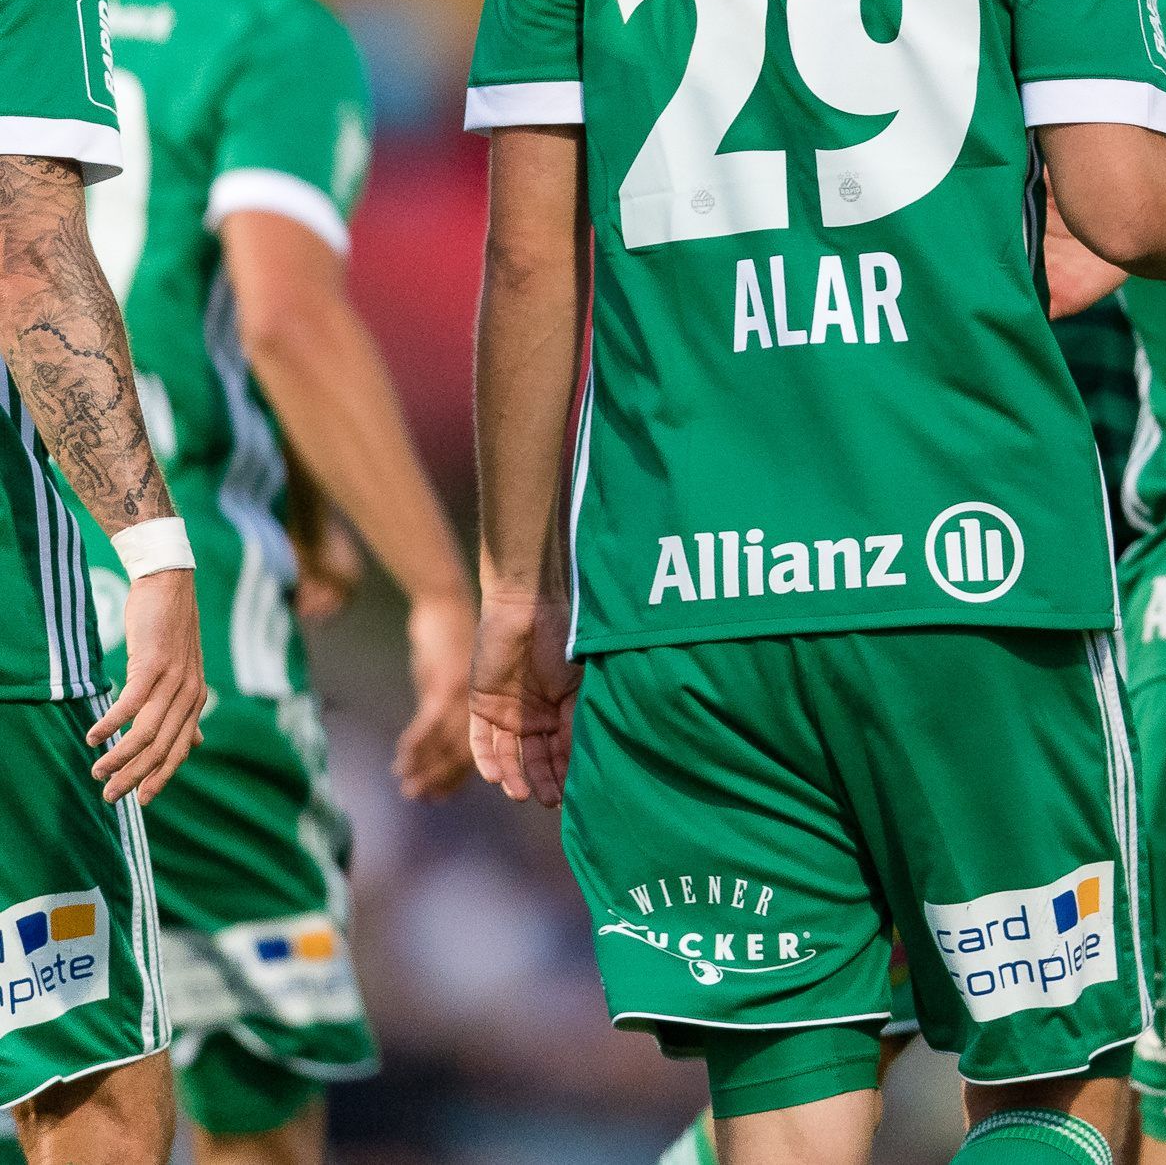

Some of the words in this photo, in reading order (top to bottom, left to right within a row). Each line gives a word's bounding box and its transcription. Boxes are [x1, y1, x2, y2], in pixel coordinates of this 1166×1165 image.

[733, 251, 909, 353] ALAR
[648, 528, 907, 606] Allianz
[628, 875, 774, 916] WIENER
[937, 905, 1031, 953] card
[0, 953, 95, 1014] plete
[951, 932, 1101, 996] omplee
